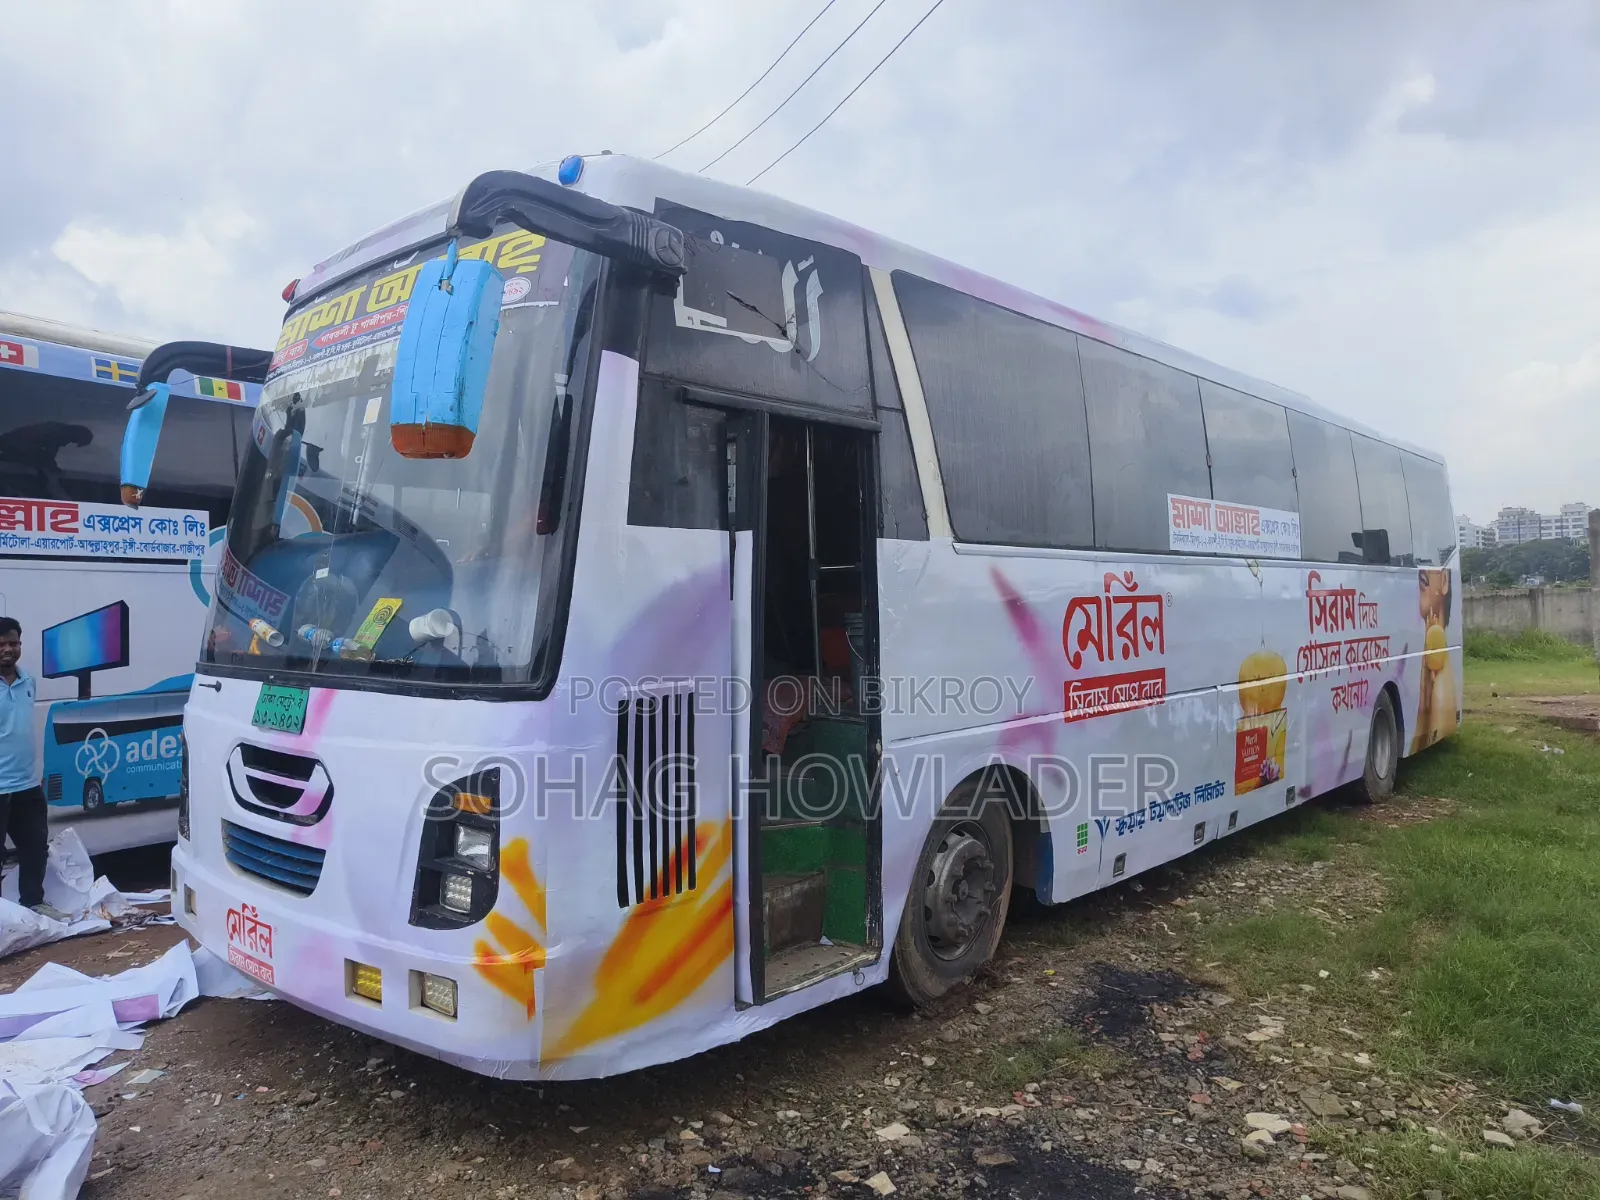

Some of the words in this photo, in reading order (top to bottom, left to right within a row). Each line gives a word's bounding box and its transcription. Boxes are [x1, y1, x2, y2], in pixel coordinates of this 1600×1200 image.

[275, 285, 367, 351] মাশা
[350, 322, 359, 335] টু
[83, 514, 144, 535] এক্সপ্রেস
[149, 517, 178, 536] কোঃ
[183, 514, 205, 537] লিঃ
[1171, 498, 1211, 532] মাশা
[1215, 504, 1261, 537] আল্লাহ
[1306, 570, 1357, 634] সিরাম
[1358, 591, 1379, 630] দিয়ে
[1297, 639, 1342, 684] গোসল
[1344, 635, 1391, 674] করেছেন
[1331, 678, 1369, 714] কখনো?
[1115, 808, 1147, 836] স্কয়ার
[1194, 780, 1226, 804] লিমিটেড
